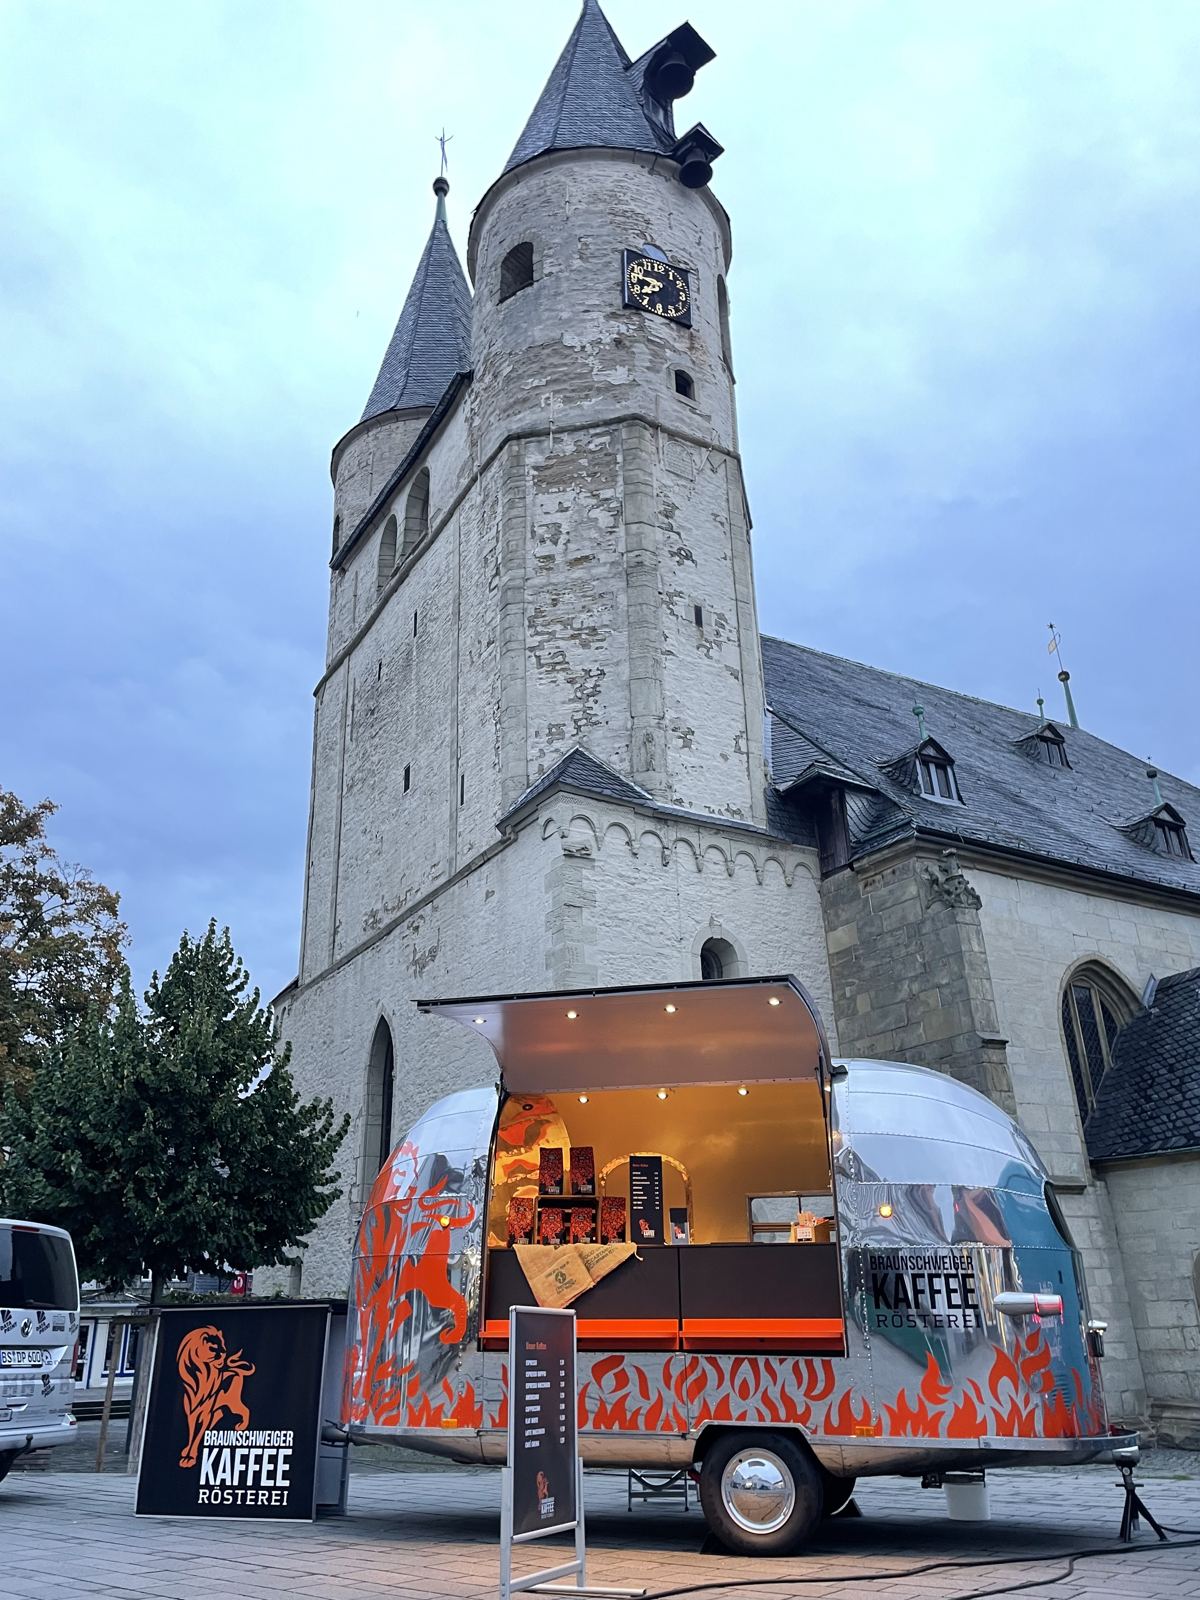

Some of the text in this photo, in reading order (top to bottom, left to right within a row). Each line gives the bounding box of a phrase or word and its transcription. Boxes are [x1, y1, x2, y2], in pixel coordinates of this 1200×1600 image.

[634, 265, 643, 274] 10
[643, 261, 651, 271] 11
[653, 263, 665, 274] 12
[668, 271, 674, 280] 1
[634, 285, 640, 293] 8
[676, 280, 682, 289] 2
[642, 295, 649, 305] 7
[679, 292, 686, 301] 3
[668, 305, 675, 314] 5
[869, 1255, 974, 1271] BRAUNSCHWEIGER
[872, 1273, 979, 1309] KAFFEE
[875, 1311, 981, 1328] RÖSTEREI
[2, 1352, 12, 1363] BS
[17, 1352, 26, 1363] DP
[28, 1352, 41, 1363] 600
[203, 1430, 294, 1447] BRAUNSCHWEIGER
[199, 1448, 293, 1487] KAFFEE
[197, 1486, 289, 1506] RÖSTEREI
